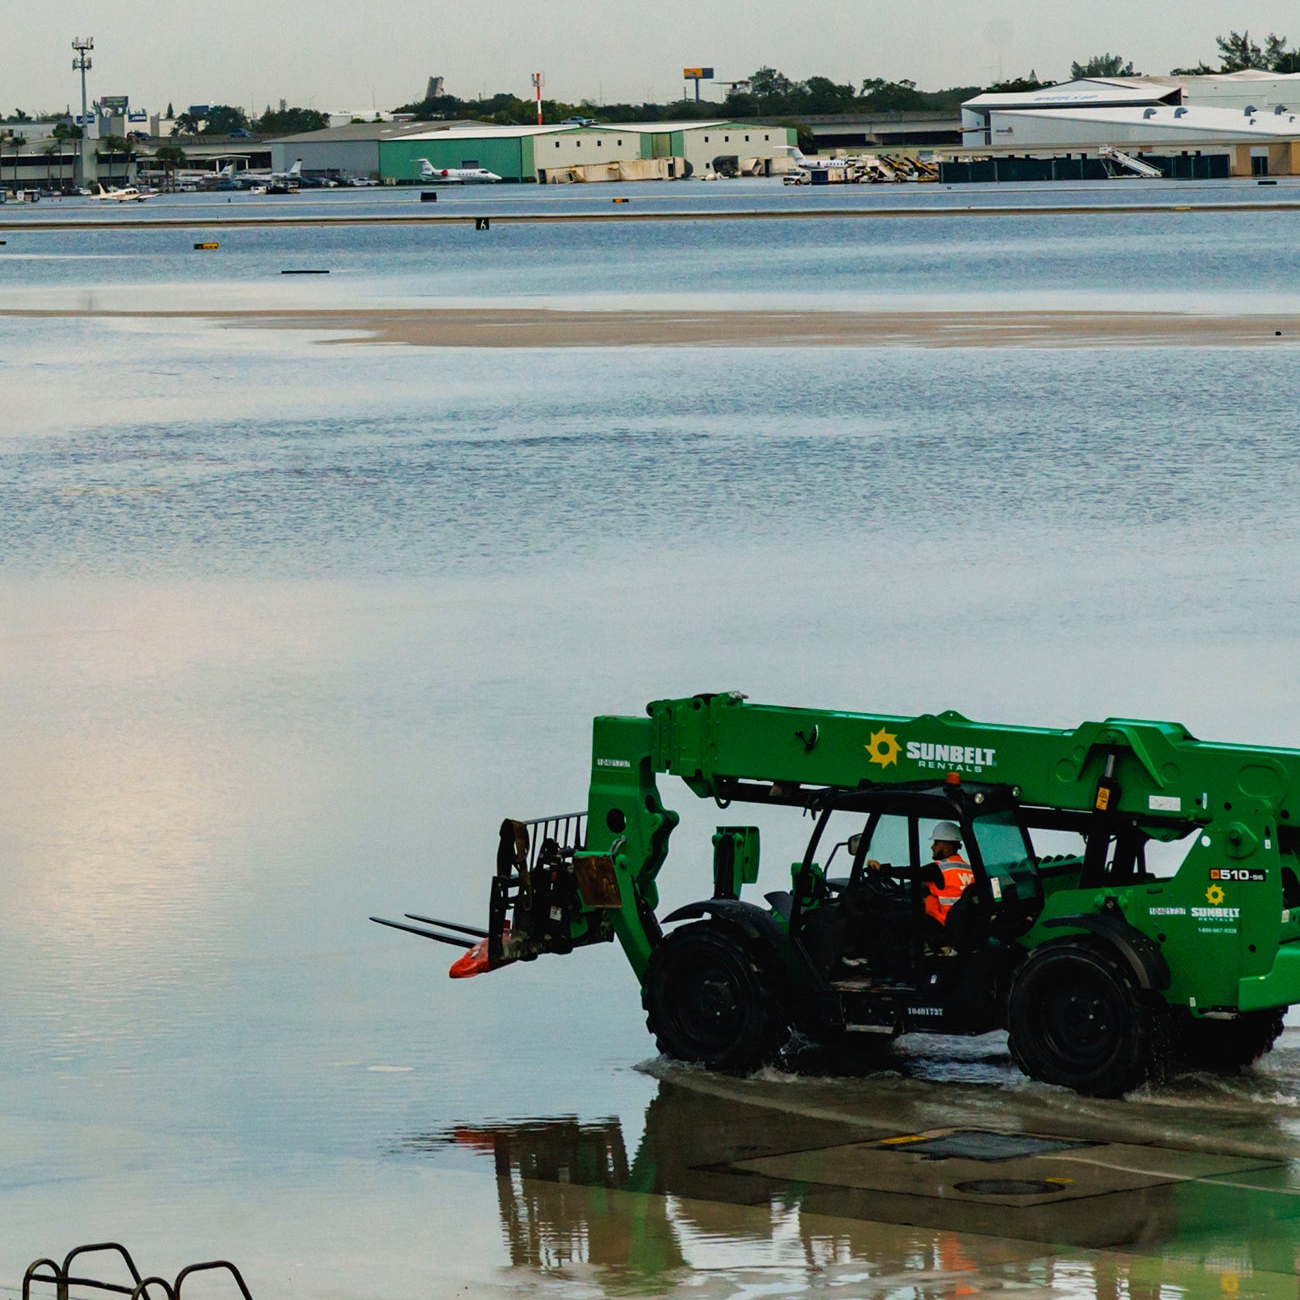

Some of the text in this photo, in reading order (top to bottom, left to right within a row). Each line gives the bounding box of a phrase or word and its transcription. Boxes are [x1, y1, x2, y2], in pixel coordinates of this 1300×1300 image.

[906, 741, 996, 766] SUNBELT
[918, 760, 983, 773] RENTALS
[1191, 908, 1241, 918] SUNBELT
